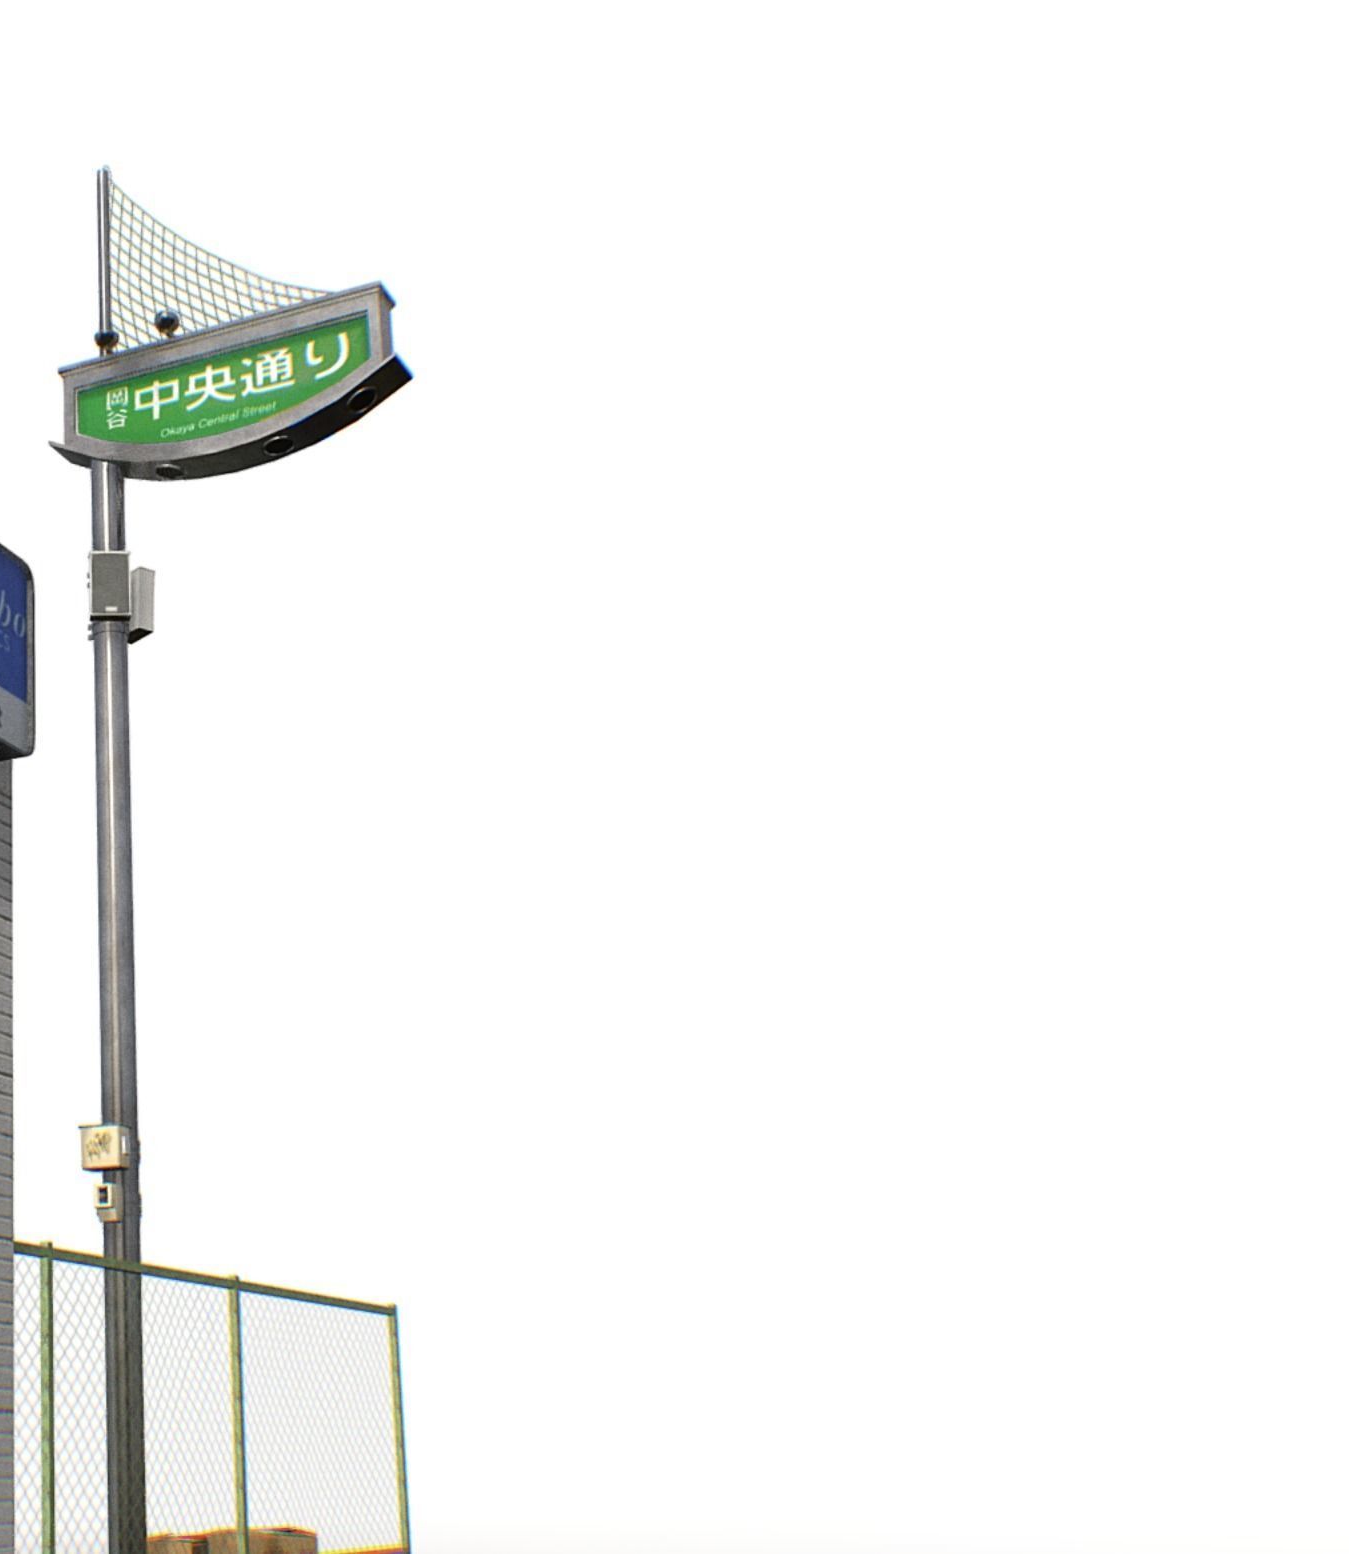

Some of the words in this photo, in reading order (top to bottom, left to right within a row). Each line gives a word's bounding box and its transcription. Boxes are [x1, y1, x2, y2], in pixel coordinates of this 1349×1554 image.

[134, 331, 349, 420] 中央通り
[106, 386, 129, 430] 岡谷
[160, 422, 195, 438] Okaya
[198, 411, 240, 429] Central
[242, 401, 277, 417] Street
